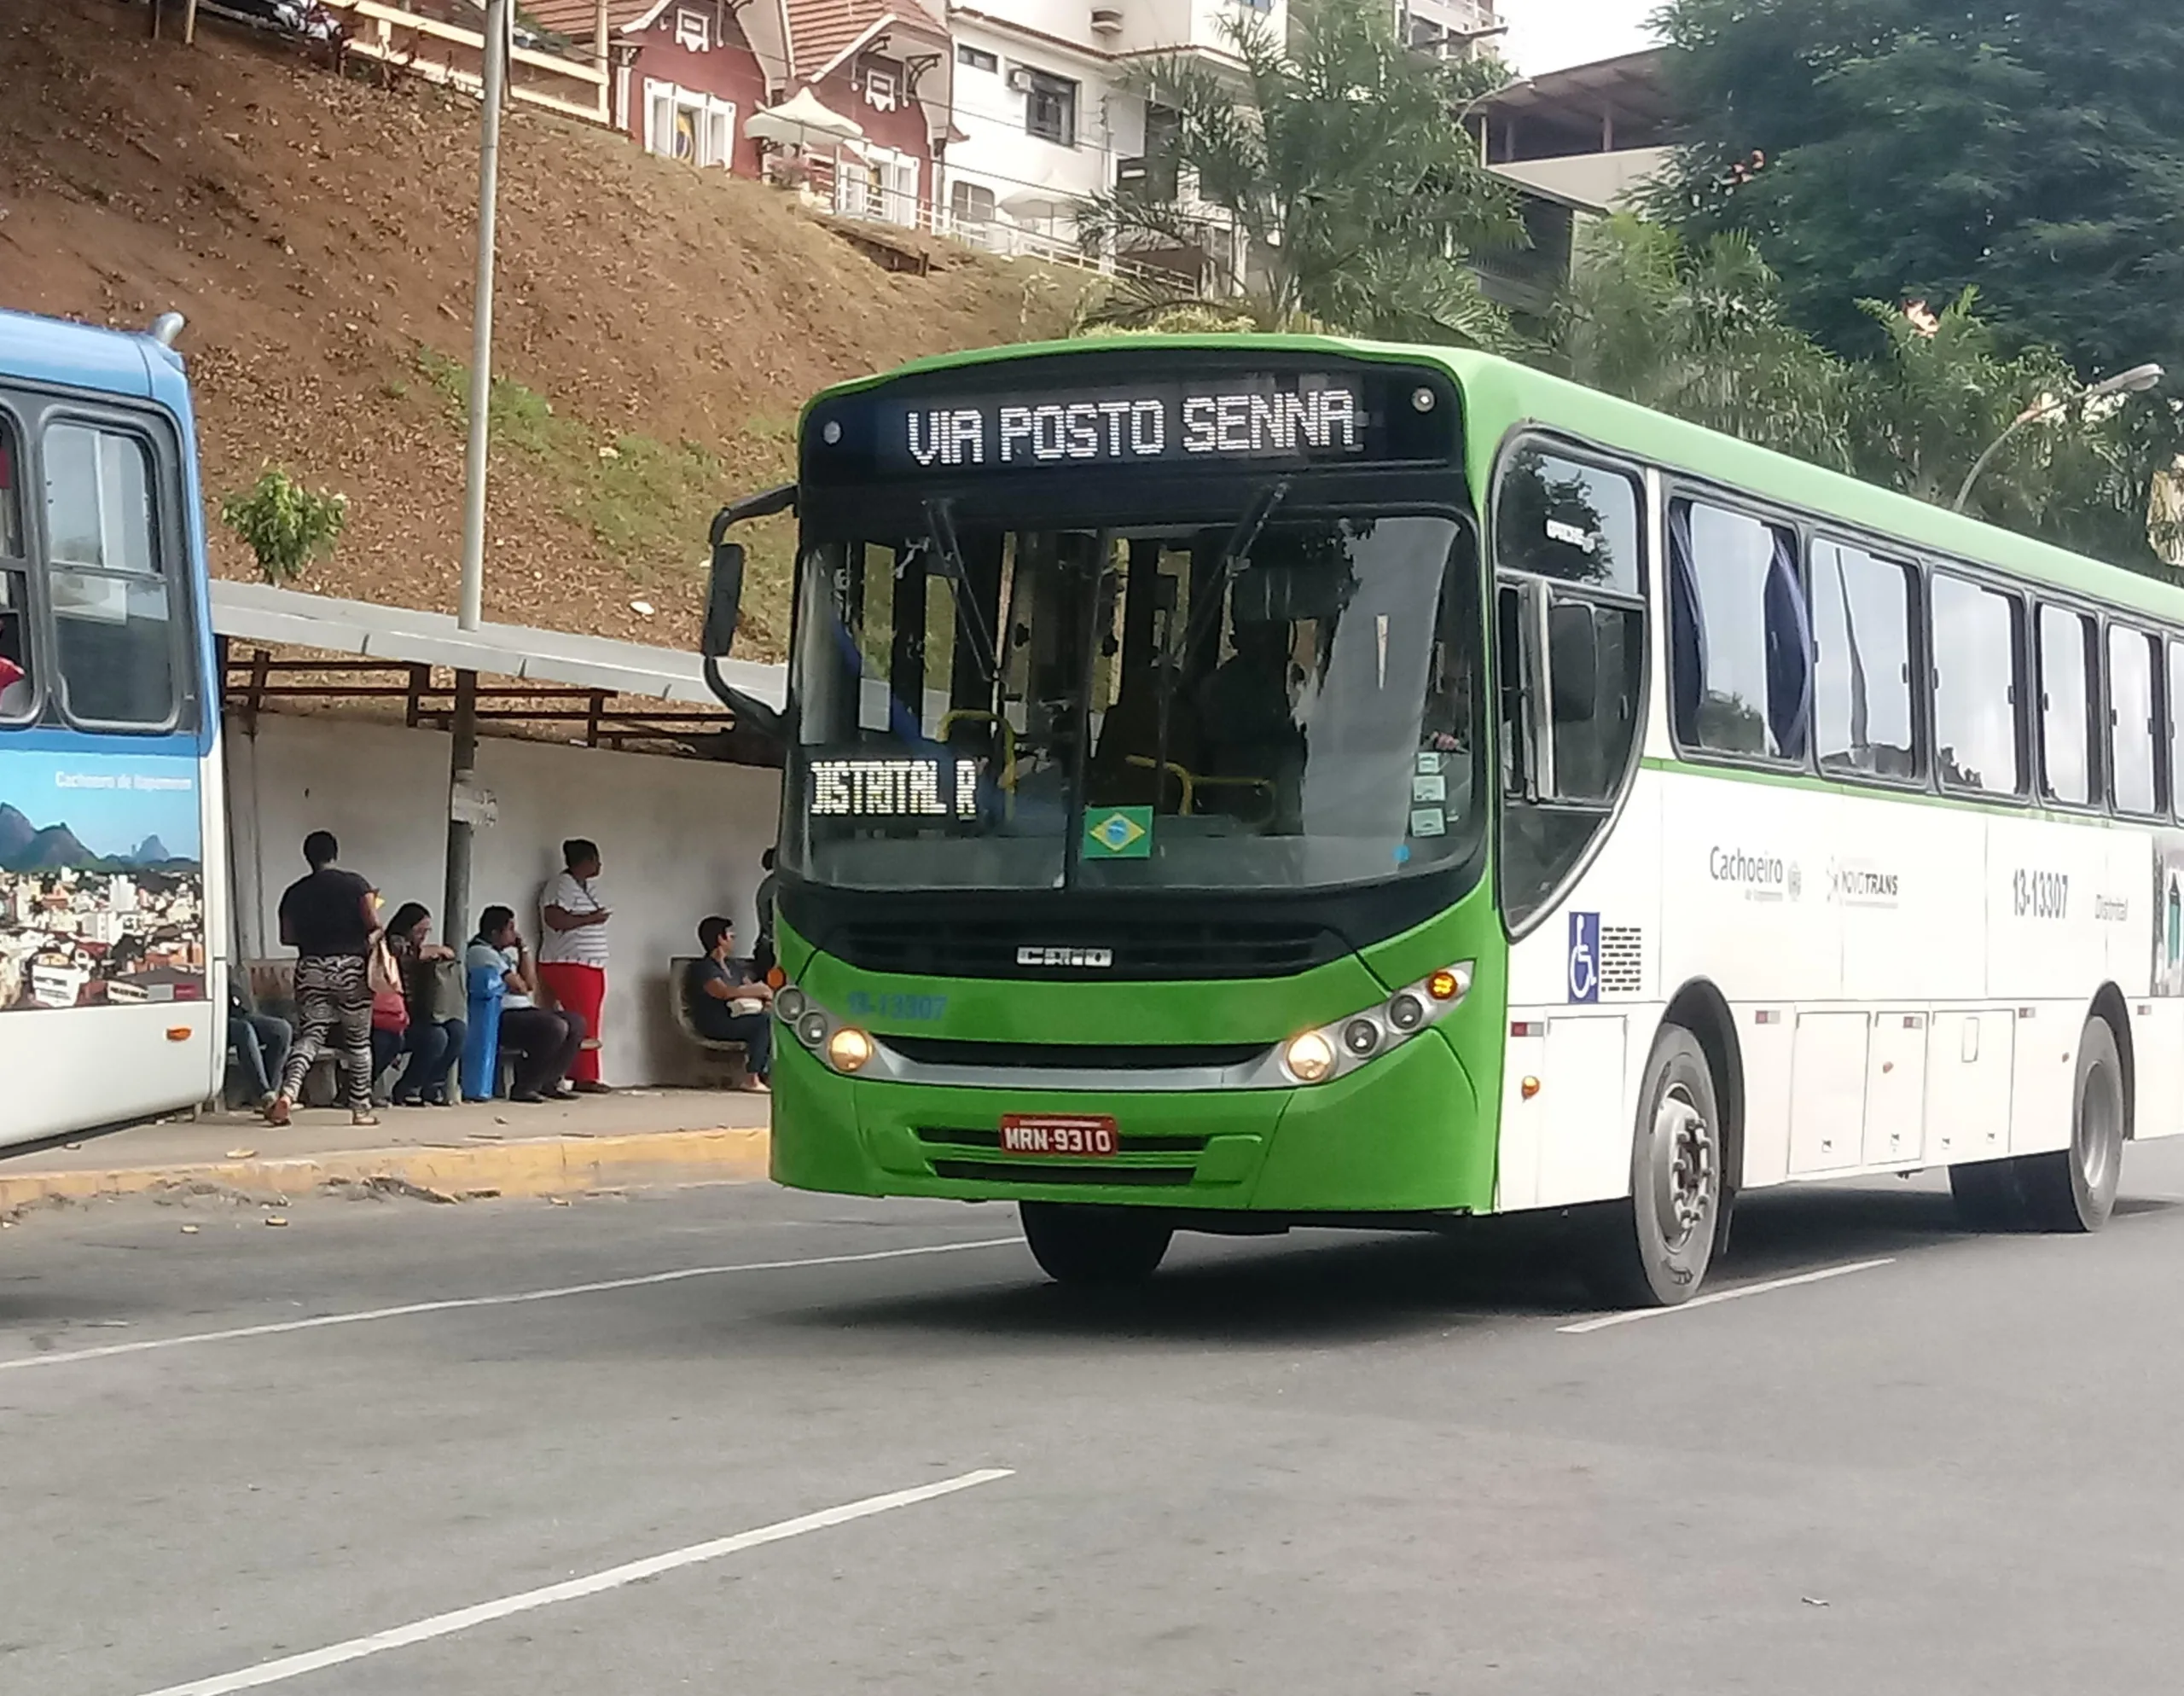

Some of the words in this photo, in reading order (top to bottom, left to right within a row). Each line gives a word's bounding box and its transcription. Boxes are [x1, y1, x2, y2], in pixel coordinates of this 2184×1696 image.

[907, 410, 984, 465] VIA
[1000, 400, 1165, 462] POSTO
[1182, 390, 1355, 454] SENNA
[1710, 845, 1783, 884] Cachoeiro
[2013, 868, 2068, 920] 13-13307
